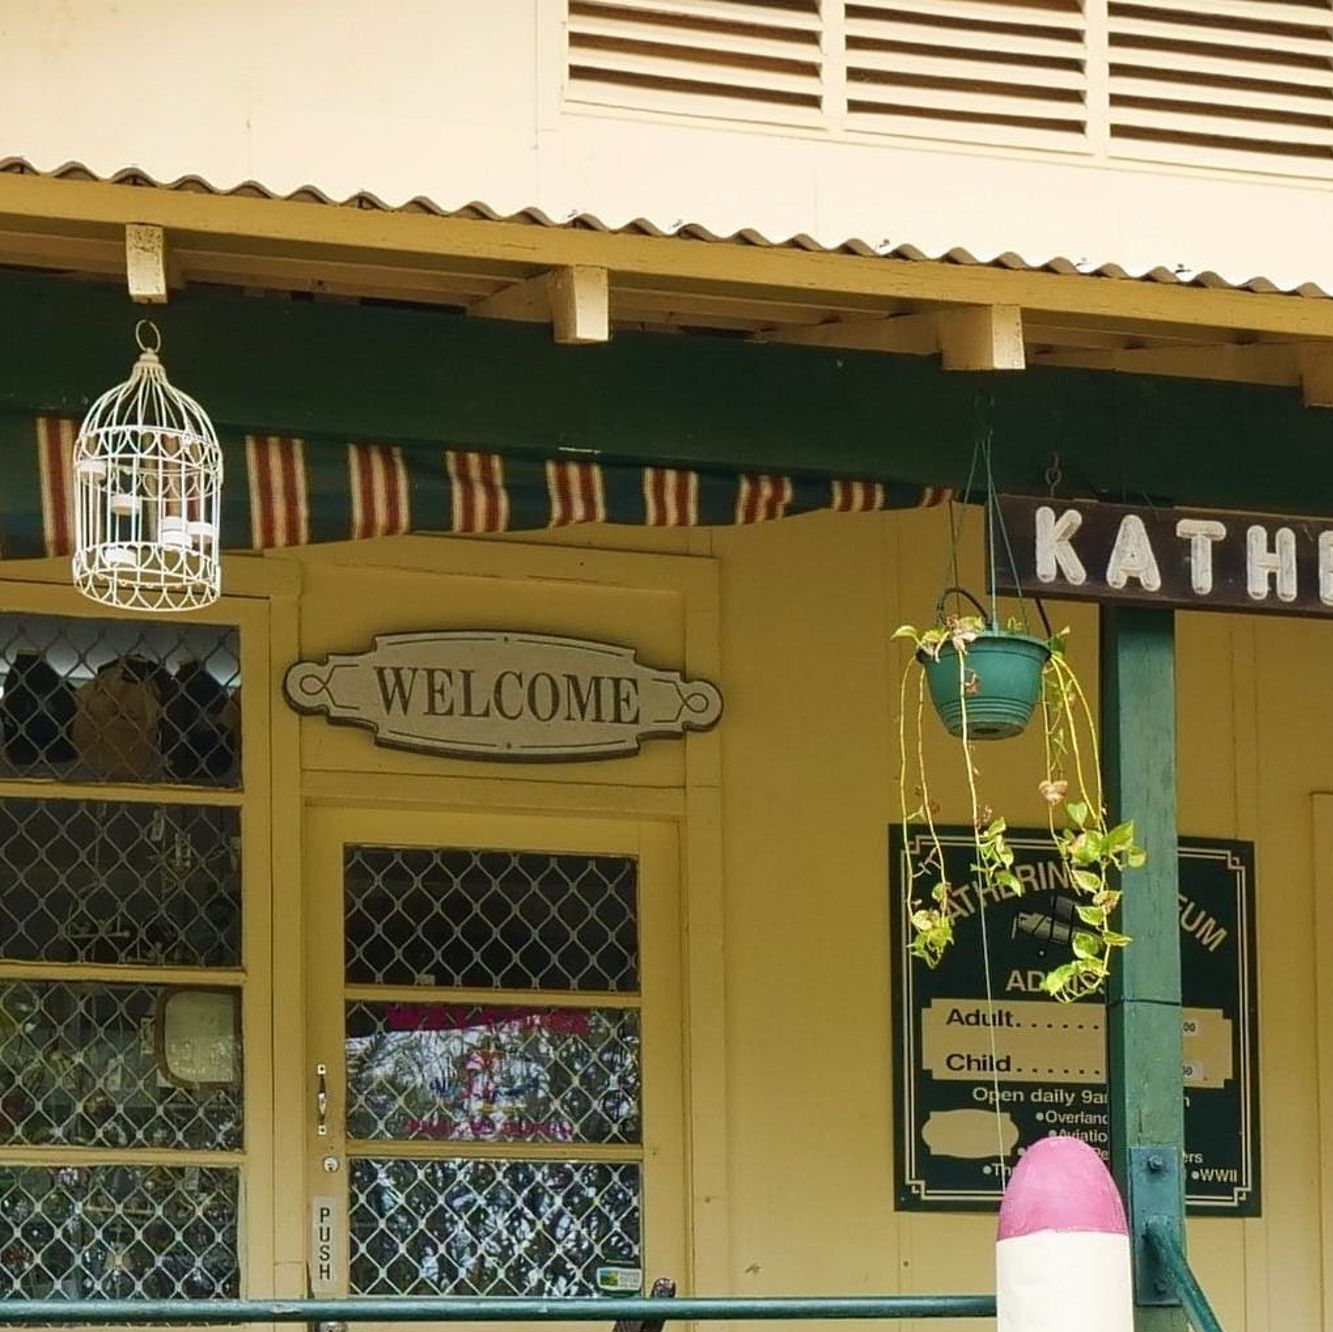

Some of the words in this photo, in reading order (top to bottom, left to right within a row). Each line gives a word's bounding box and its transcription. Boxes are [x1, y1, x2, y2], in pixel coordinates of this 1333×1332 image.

[374, 664, 642, 726] WELCOME
[946, 1053, 1012, 1073] Child
[972, 1086, 1024, 1105] Open
[1030, 1086, 1076, 1106] daily
[1081, 1089, 1108, 1105] 9a
[317, 1206, 333, 1281] PUSH
